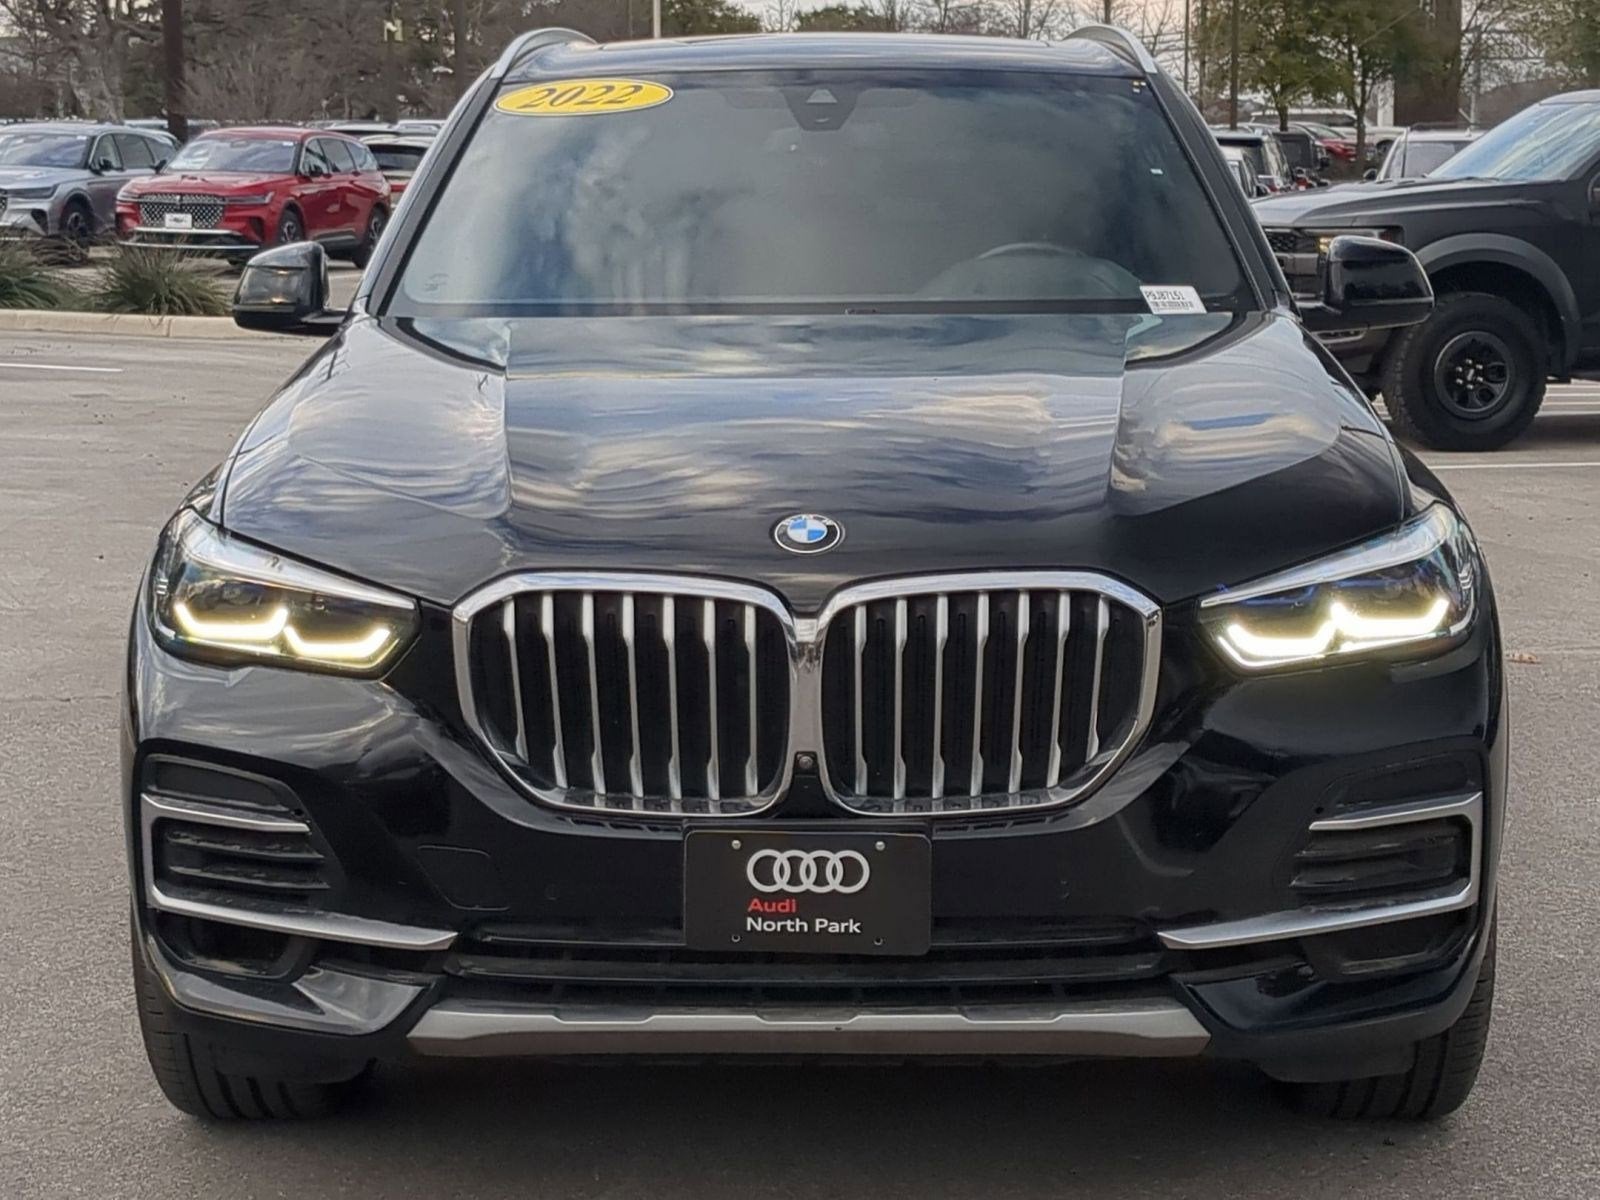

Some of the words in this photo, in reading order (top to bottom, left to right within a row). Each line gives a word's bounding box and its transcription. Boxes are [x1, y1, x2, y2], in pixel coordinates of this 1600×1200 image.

[516, 84, 643, 110] 2022
[747, 898, 796, 913] Audi
[746, 917, 808, 933] North
[815, 918, 861, 933] Park
